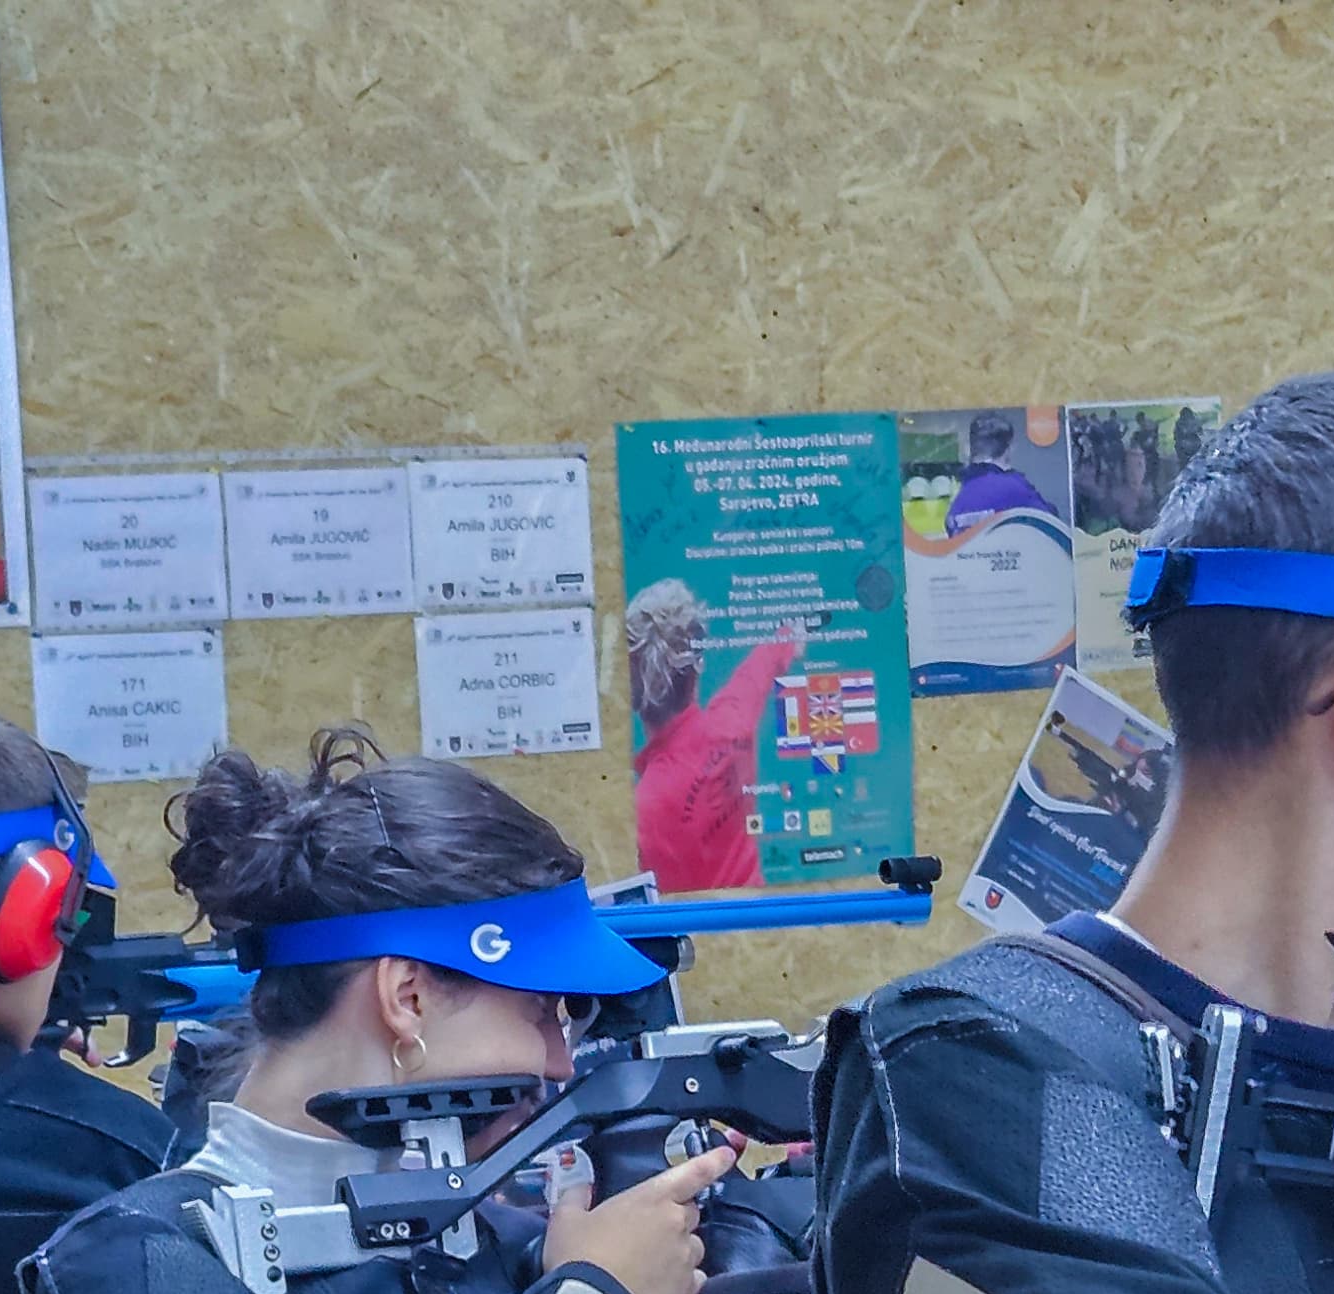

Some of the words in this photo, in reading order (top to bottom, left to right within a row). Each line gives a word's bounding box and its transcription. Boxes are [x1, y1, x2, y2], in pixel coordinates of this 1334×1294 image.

[652, 440, 673, 455] 16.
[487, 493, 514, 510] 210
[778, 492, 820, 508] ZETRA
[121, 514, 139, 530] 20
[447, 518, 486, 533] Amila
[490, 547, 516, 563] BIH
[494, 651, 519, 667] 211
[121, 678, 147, 693] 171
[459, 677, 495, 692] Adna
[88, 703, 129, 718] Anisa
[497, 705, 522, 721] BIH
[122, 733, 150, 749] BIH
[469, 922, 512, 964] G
